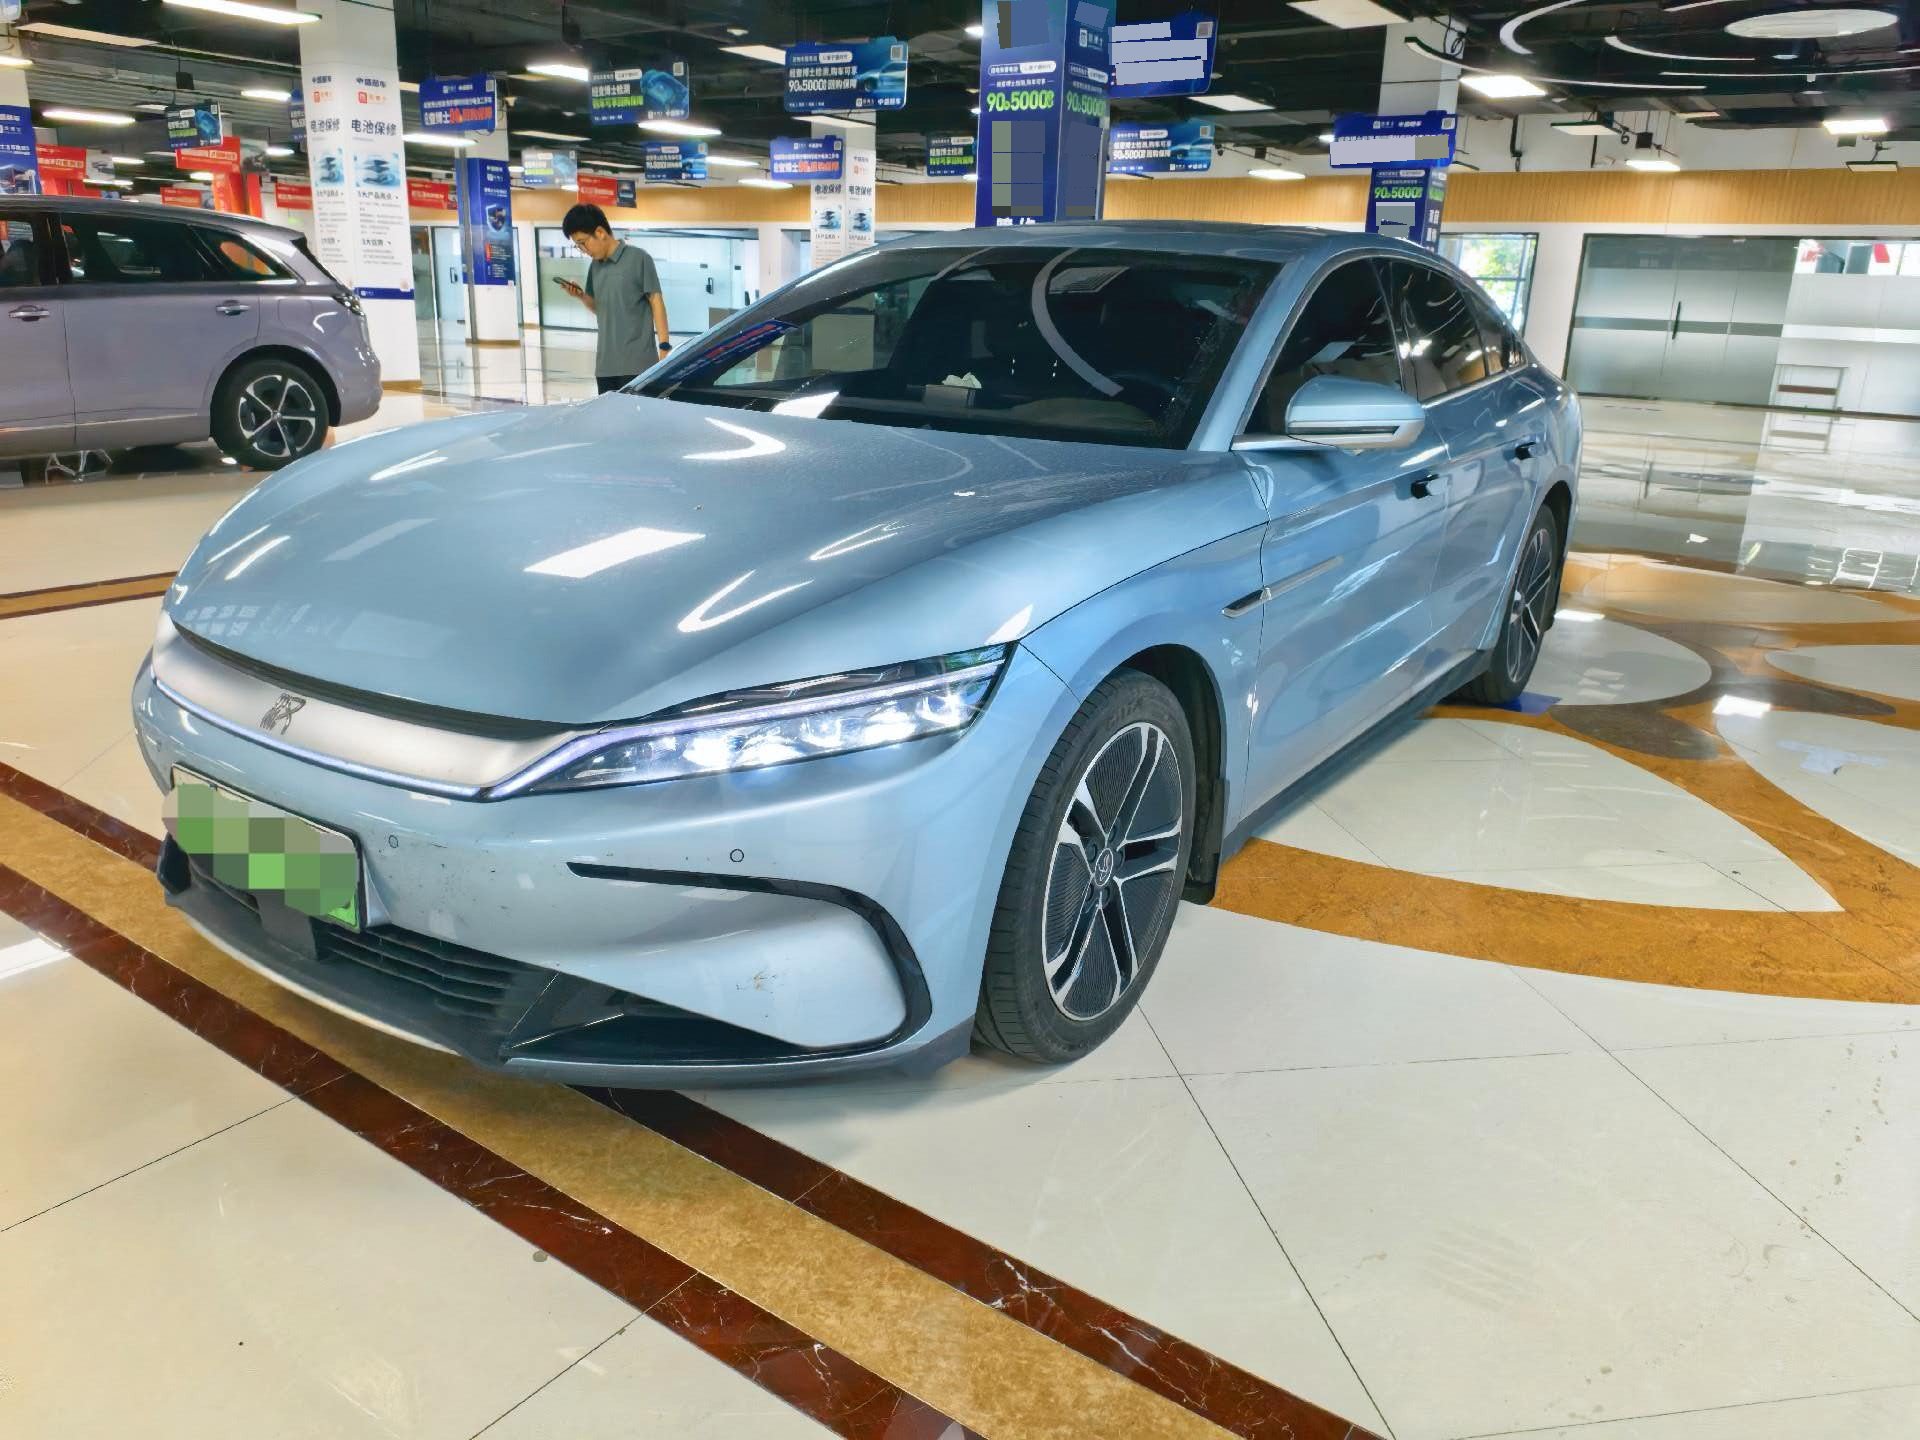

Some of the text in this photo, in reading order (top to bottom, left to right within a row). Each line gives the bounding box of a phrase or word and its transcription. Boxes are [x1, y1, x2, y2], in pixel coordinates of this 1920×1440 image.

[310, 119, 340, 132] 电池保修
[351, 119, 397, 136] 电池保修
